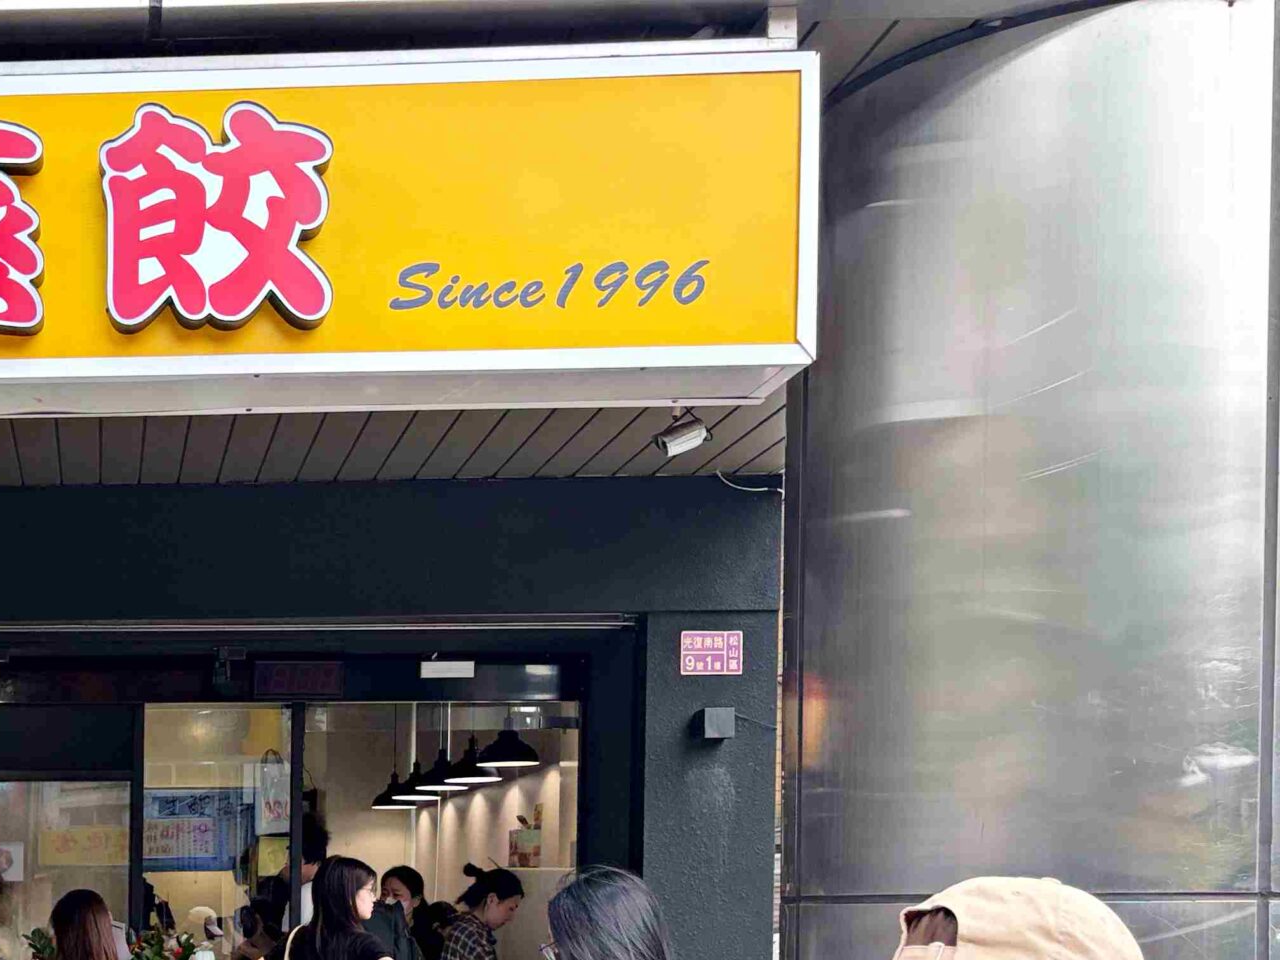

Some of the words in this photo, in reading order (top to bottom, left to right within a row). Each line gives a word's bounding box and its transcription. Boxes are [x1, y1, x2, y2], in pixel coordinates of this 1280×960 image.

[683, 635, 724, 649] 光復南路
[728, 634, 739, 670] 松山區
